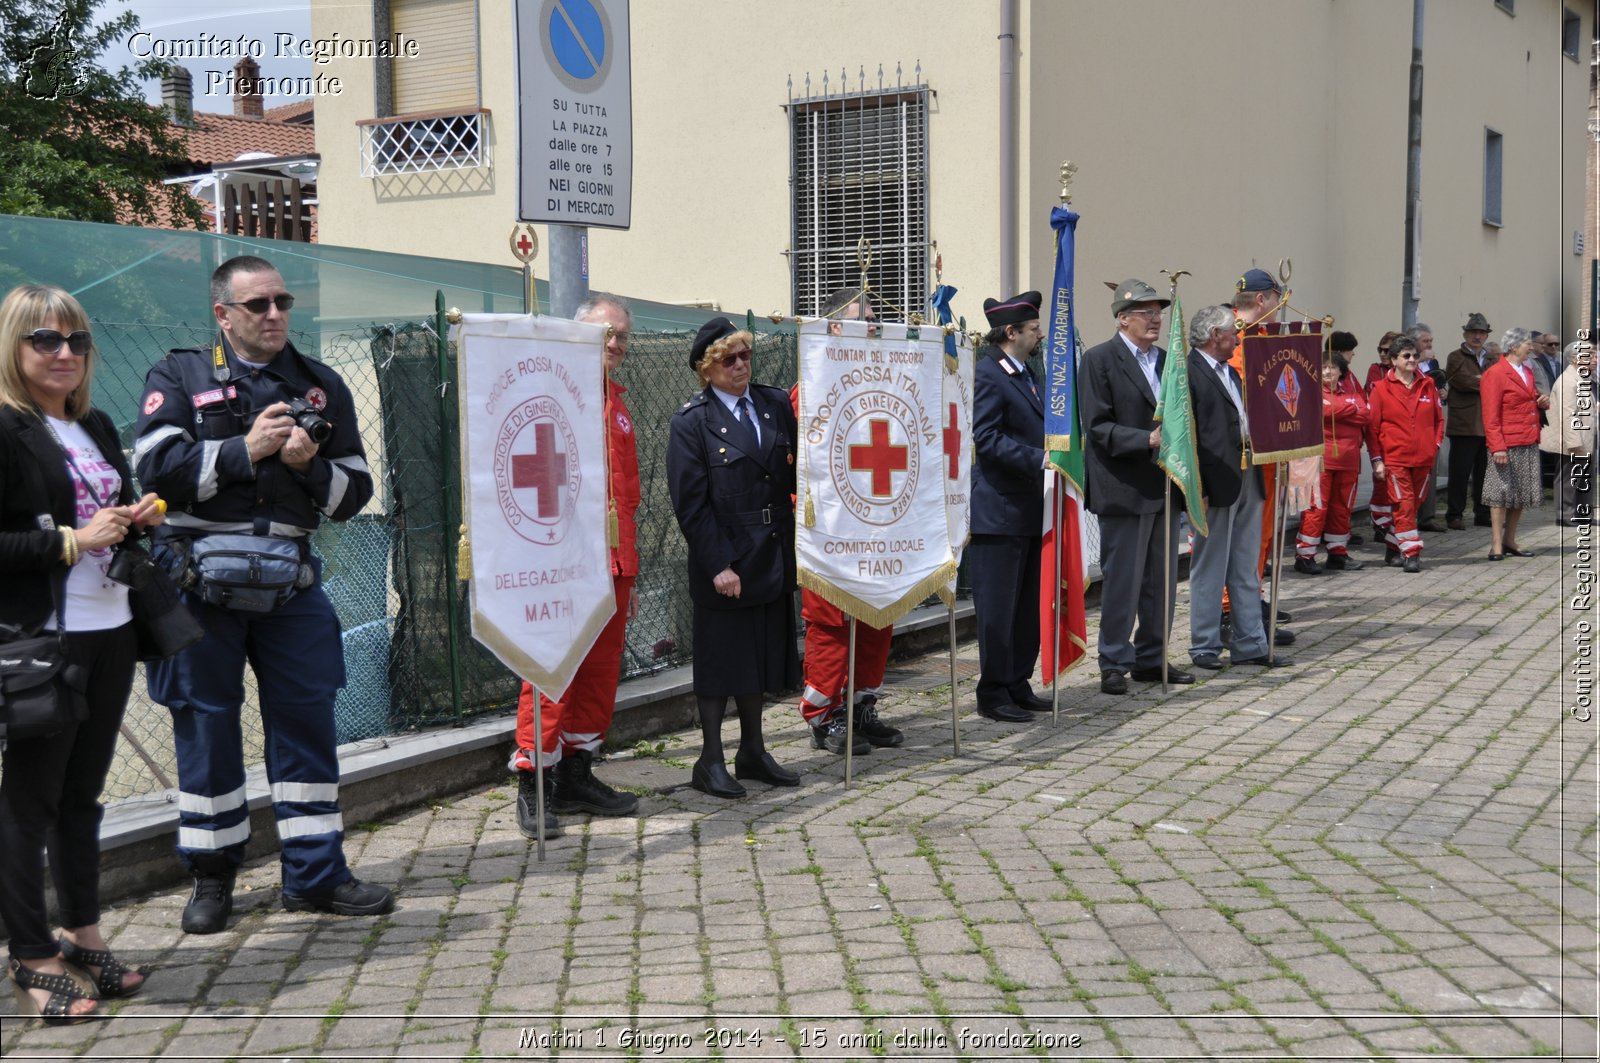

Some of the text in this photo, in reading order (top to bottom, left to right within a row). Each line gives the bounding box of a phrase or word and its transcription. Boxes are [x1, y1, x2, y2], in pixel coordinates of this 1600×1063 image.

[552, 98, 607, 118] SU TUTTA
[552, 119, 608, 138] LA PIAZZA
[549, 138, 612, 156] dalle ore 7
[549, 158, 613, 177] alle ore 15
[549, 177, 614, 197] NEI GIORNI
[547, 198, 615, 217] DI MERCATO
[1053, 287, 1071, 355] CARABINIERI
[825, 346, 867, 363] VOLONTARI
[870, 350, 885, 364] DEL
[518, 356, 553, 377] ROSSA
[806, 382, 841, 445] CROCE
[840, 366, 893, 391] ROSSA
[843, 405, 857, 422] DI
[859, 394, 908, 420] GINEVRA
[906, 420, 916, 437] 22
[495, 424, 523, 527] CONVENZIONE
[511, 413, 525, 429] DI
[833, 424, 871, 519] CONVENZIONE
[823, 538, 926, 555] COMITATO LOCALE
[858, 558, 903, 577] FIANO
